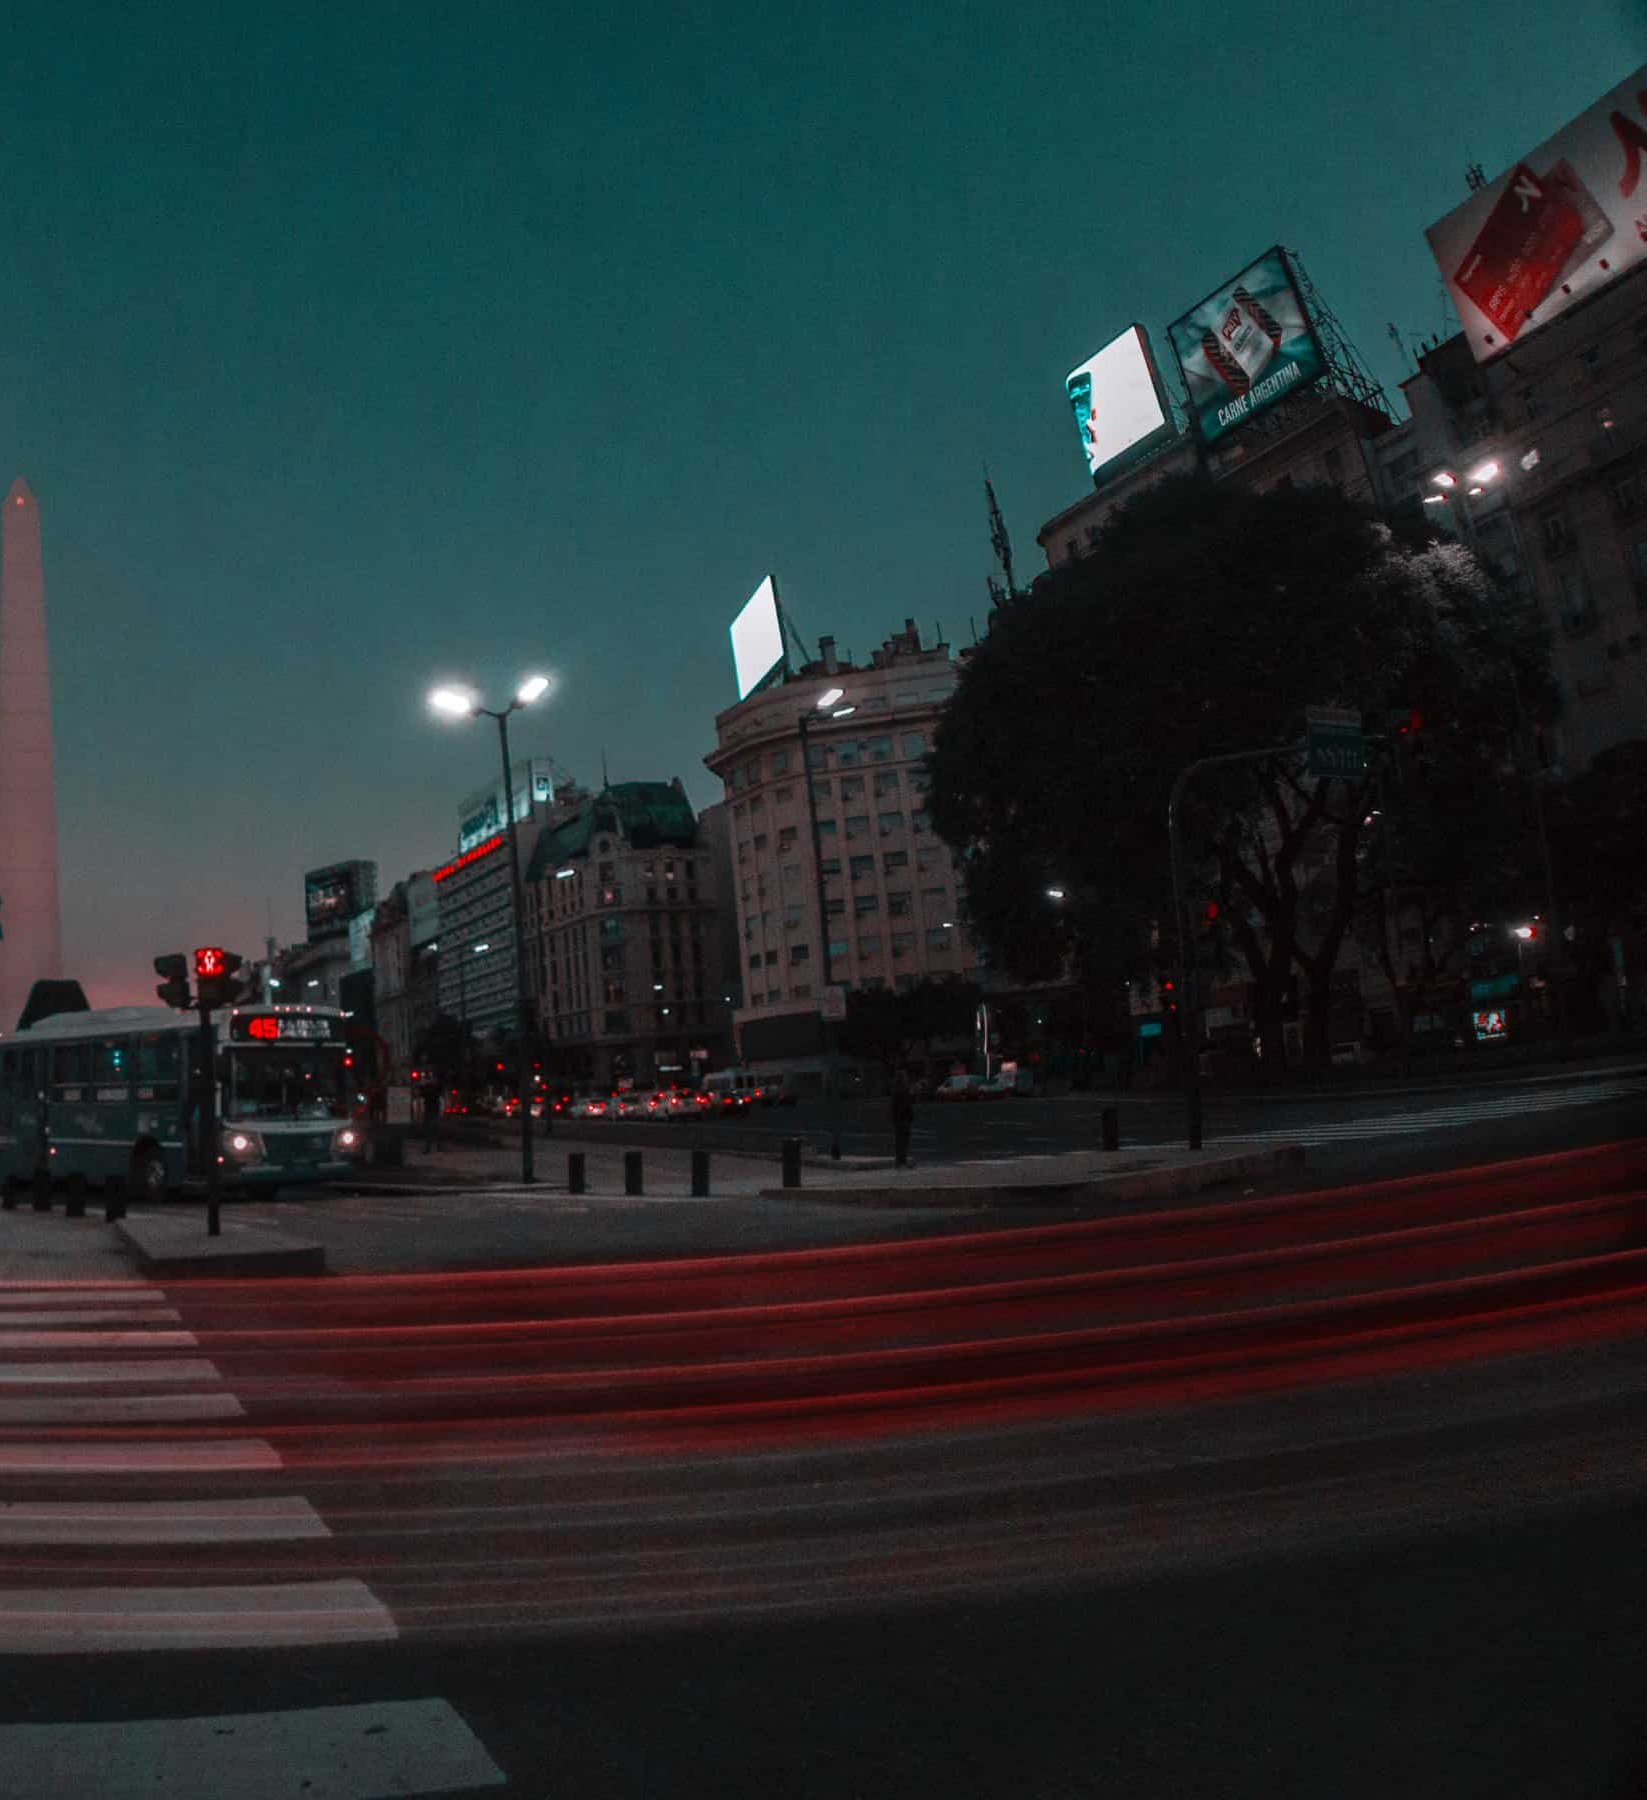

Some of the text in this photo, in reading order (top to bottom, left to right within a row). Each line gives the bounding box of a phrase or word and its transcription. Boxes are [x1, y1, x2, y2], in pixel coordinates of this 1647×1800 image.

[1217, 360, 1303, 427] CARNE ARGENTINA
[248, 1017, 279, 1039] 45
